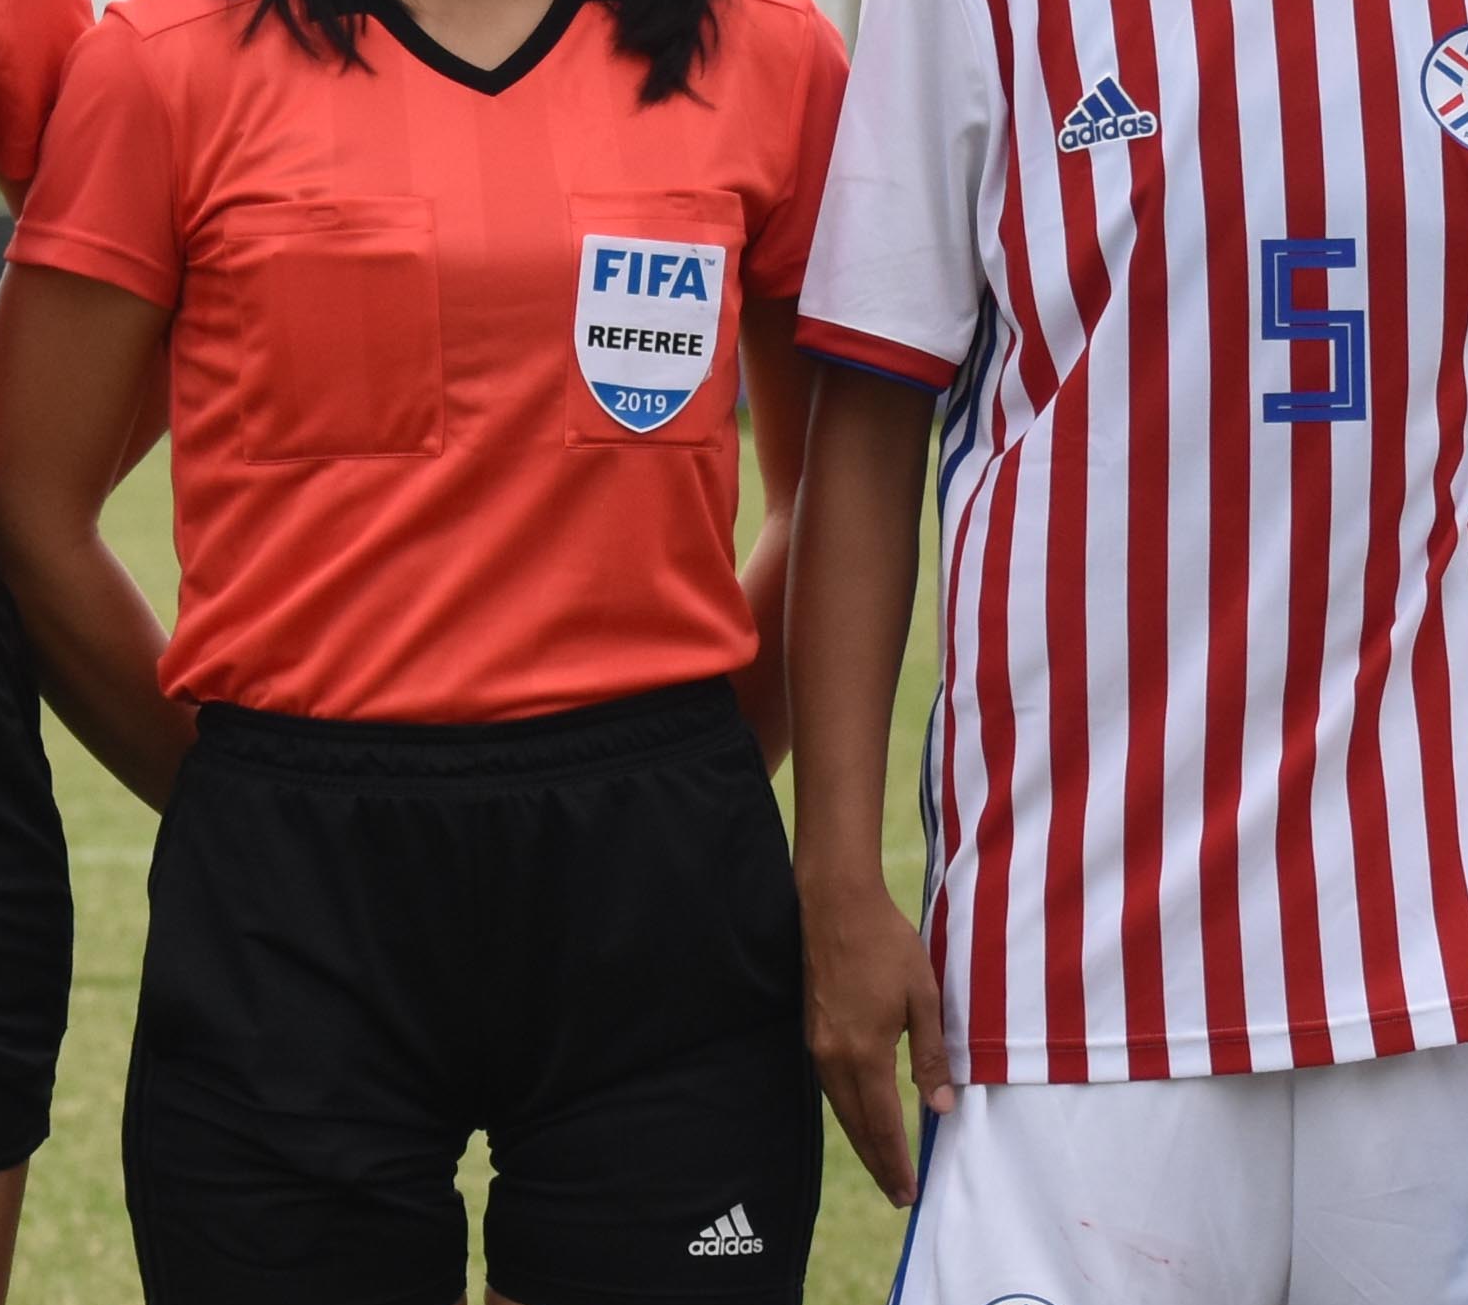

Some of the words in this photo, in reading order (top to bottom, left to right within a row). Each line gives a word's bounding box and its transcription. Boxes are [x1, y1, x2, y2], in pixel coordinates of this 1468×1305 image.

[1061, 115, 1154, 150] adidas
[593, 249, 707, 301] FIFA
[587, 324, 703, 357] REFEREE
[1261, 237, 1366, 423] 5
[615, 391, 667, 414] 2019
[688, 1236, 764, 1256] adidas
